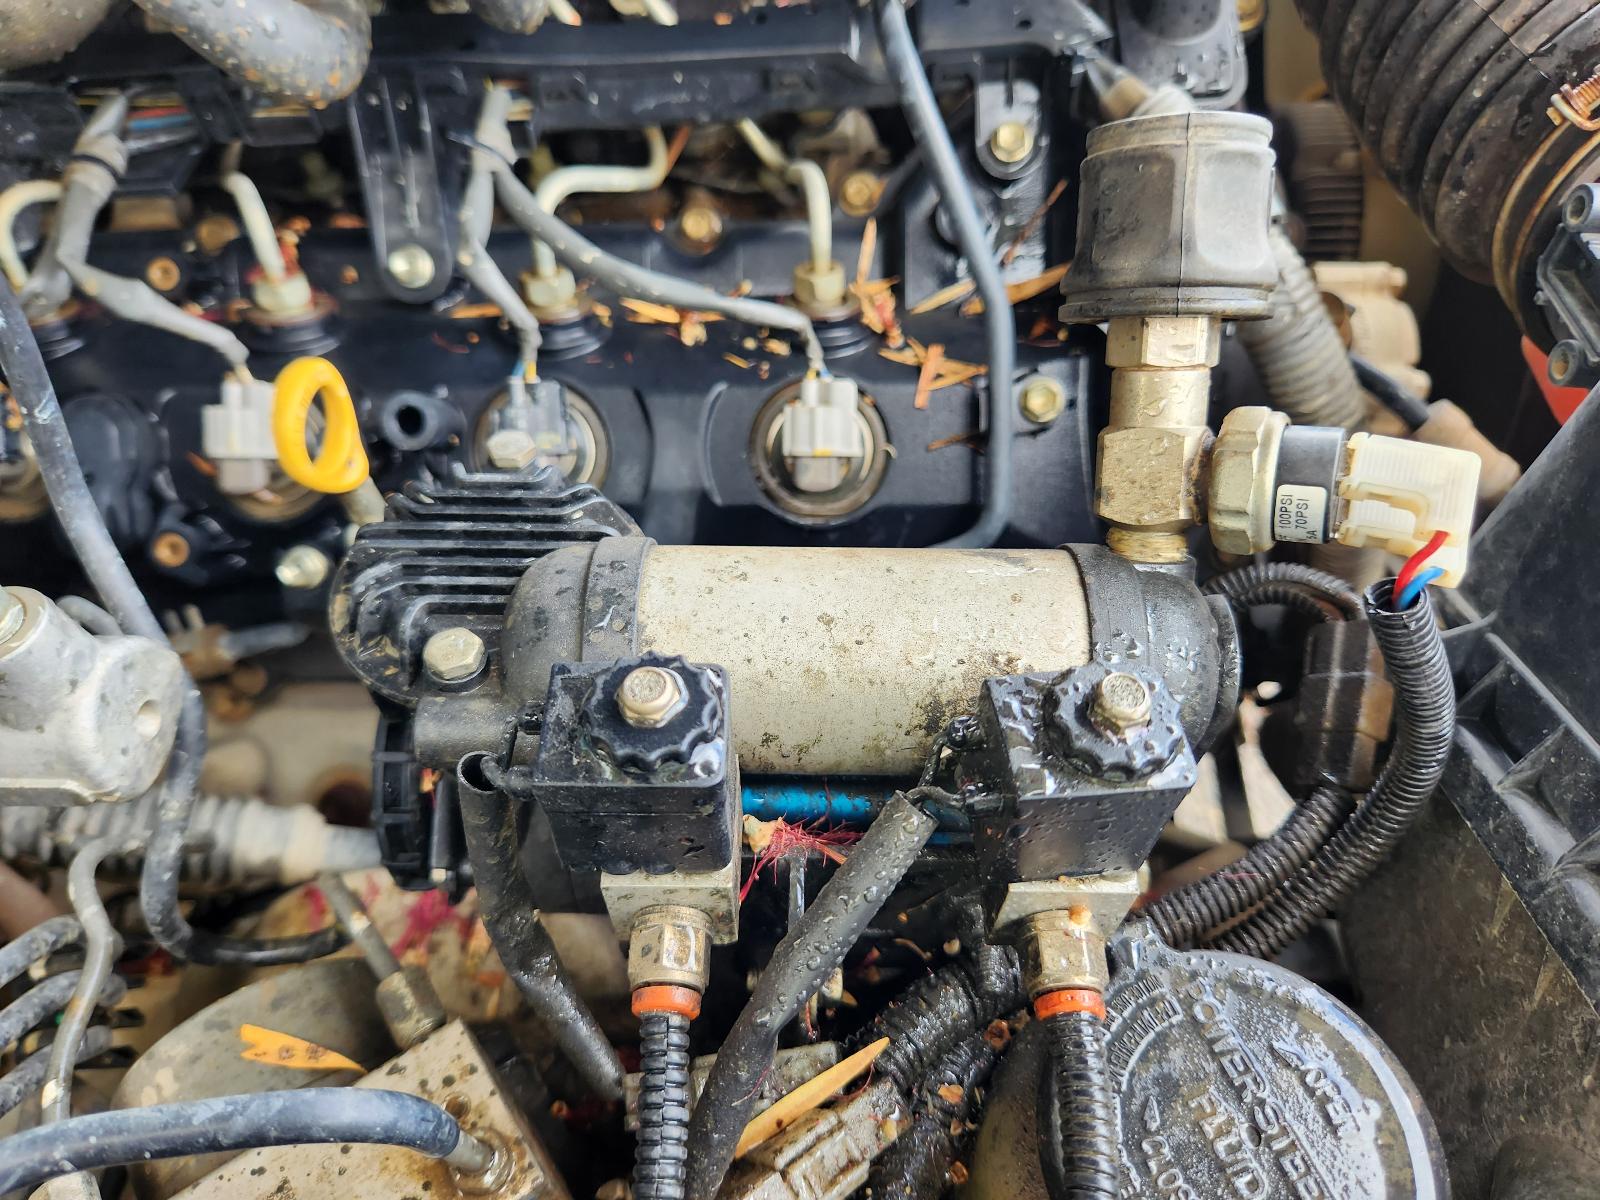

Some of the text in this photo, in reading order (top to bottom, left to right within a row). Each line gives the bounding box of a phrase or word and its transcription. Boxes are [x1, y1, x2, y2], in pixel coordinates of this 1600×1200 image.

[1278, 494, 1293, 529] 100PSI
[1295, 498, 1310, 530] 70PSI
[1182, 976, 1268, 1103] POWER
[1188, 1087, 1268, 1200] FLUID
